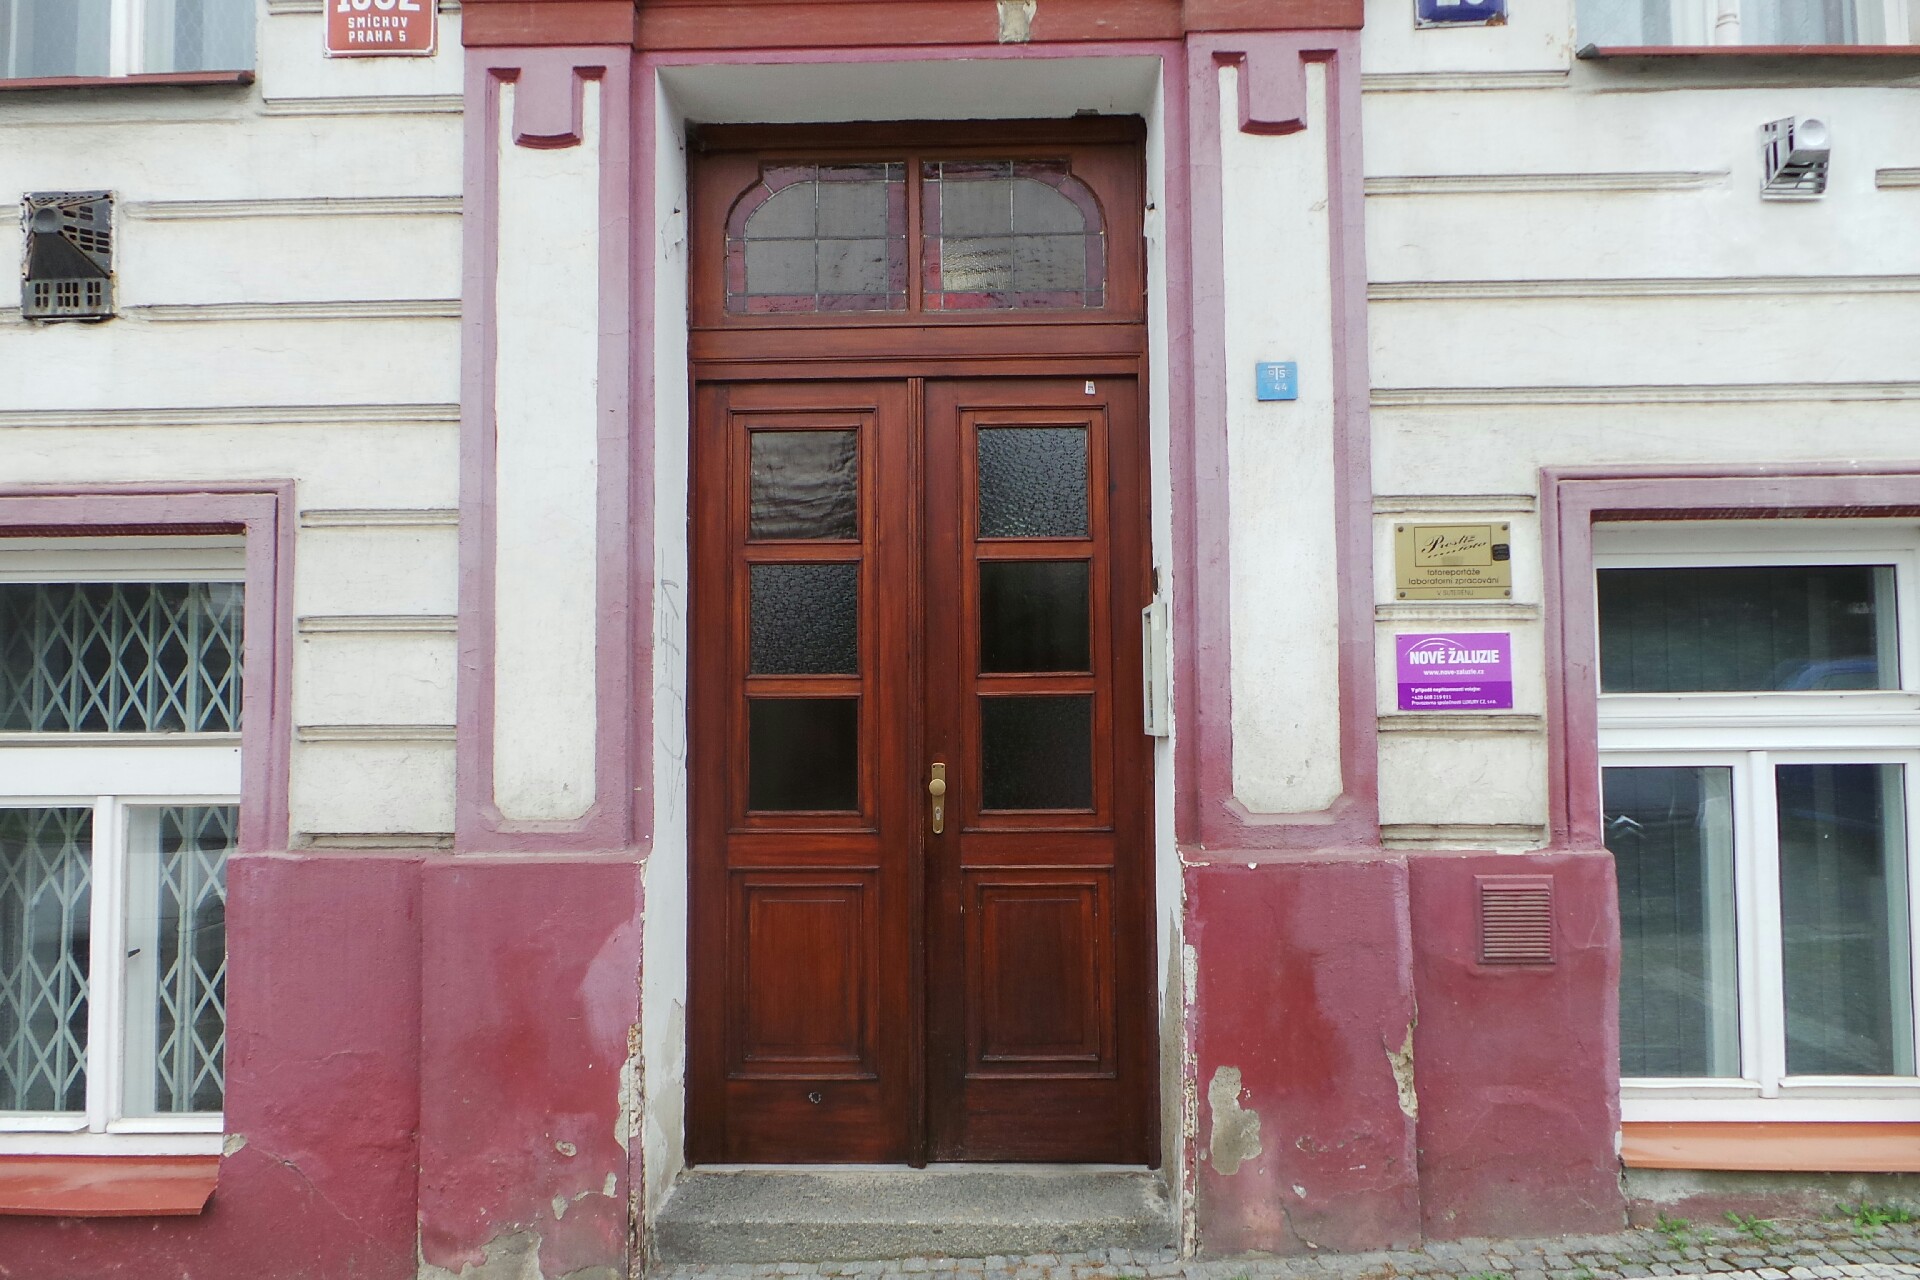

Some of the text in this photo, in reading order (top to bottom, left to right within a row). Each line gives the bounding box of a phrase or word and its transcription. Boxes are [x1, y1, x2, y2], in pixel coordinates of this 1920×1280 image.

[348, 14, 408, 28] SMÍCHOV
[348, 30, 406, 42] PRAHA 5
[1274, 382, 1287, 391] 44
[1427, 568, 1481, 577] fotoreportáže
[1455, 577, 1499, 585] zpracování
[1409, 647, 1500, 665] NOVÉ ŽALUZIE
